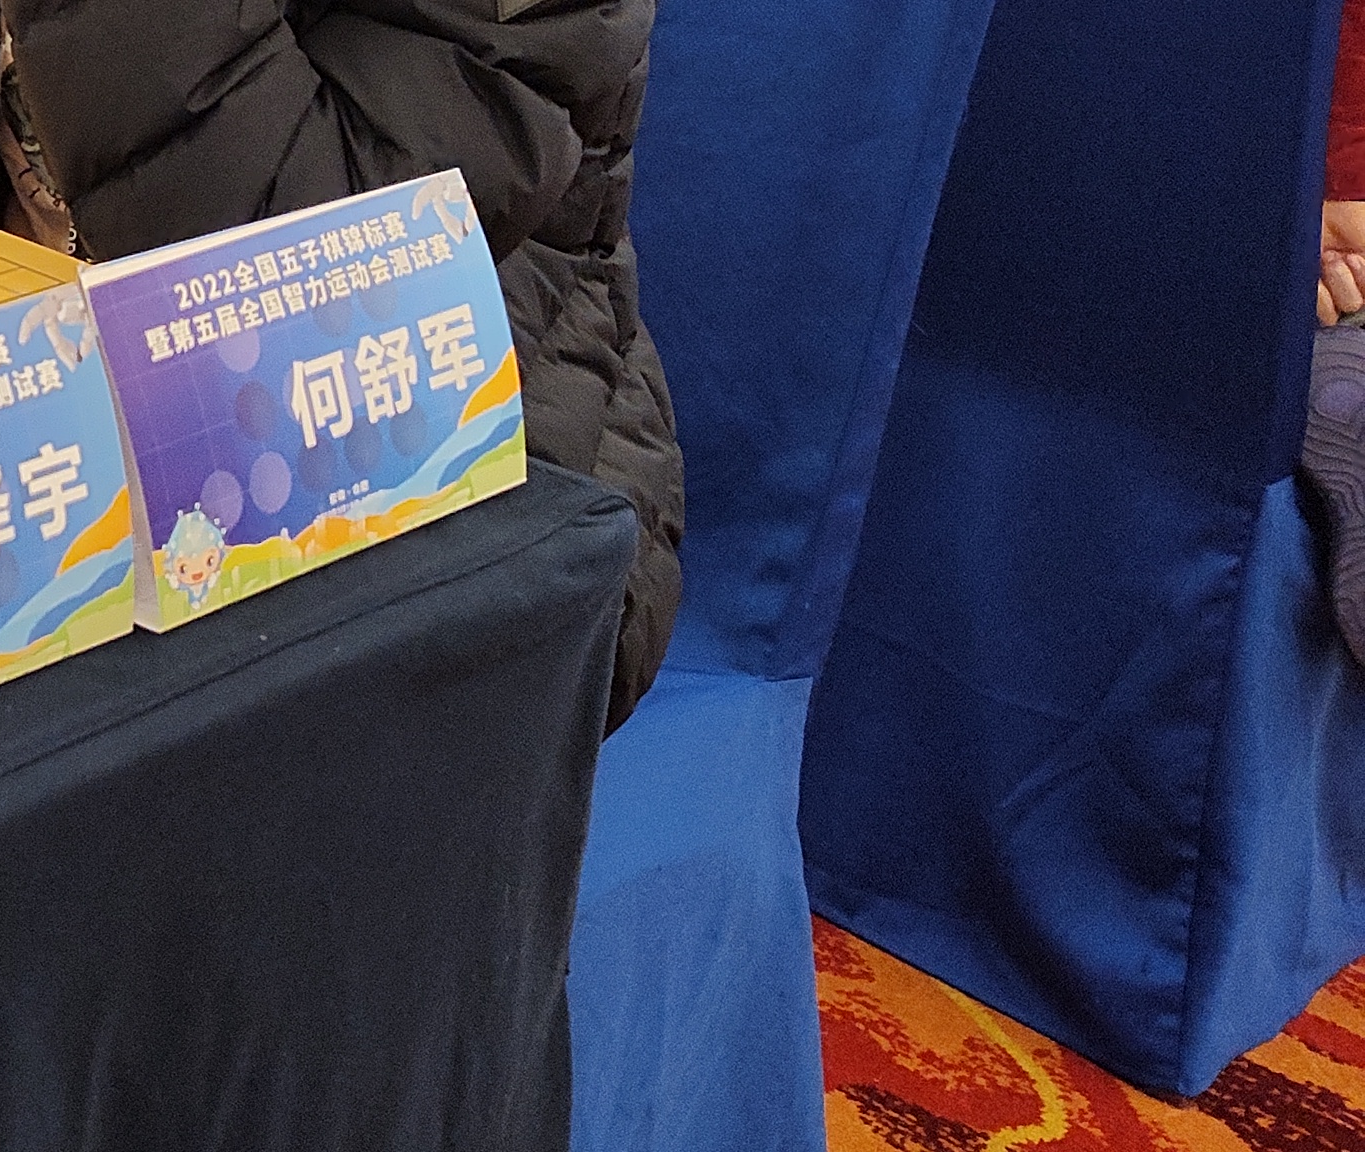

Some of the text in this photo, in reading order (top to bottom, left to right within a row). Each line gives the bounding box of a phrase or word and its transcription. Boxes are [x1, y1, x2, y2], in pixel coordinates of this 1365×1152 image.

[144, 234, 455, 363] 暨第五届全国智力运动会测试赛
[174, 211, 408, 311] 2022全国五子棋锦标赛
[291, 303, 486, 449] 何舒军
